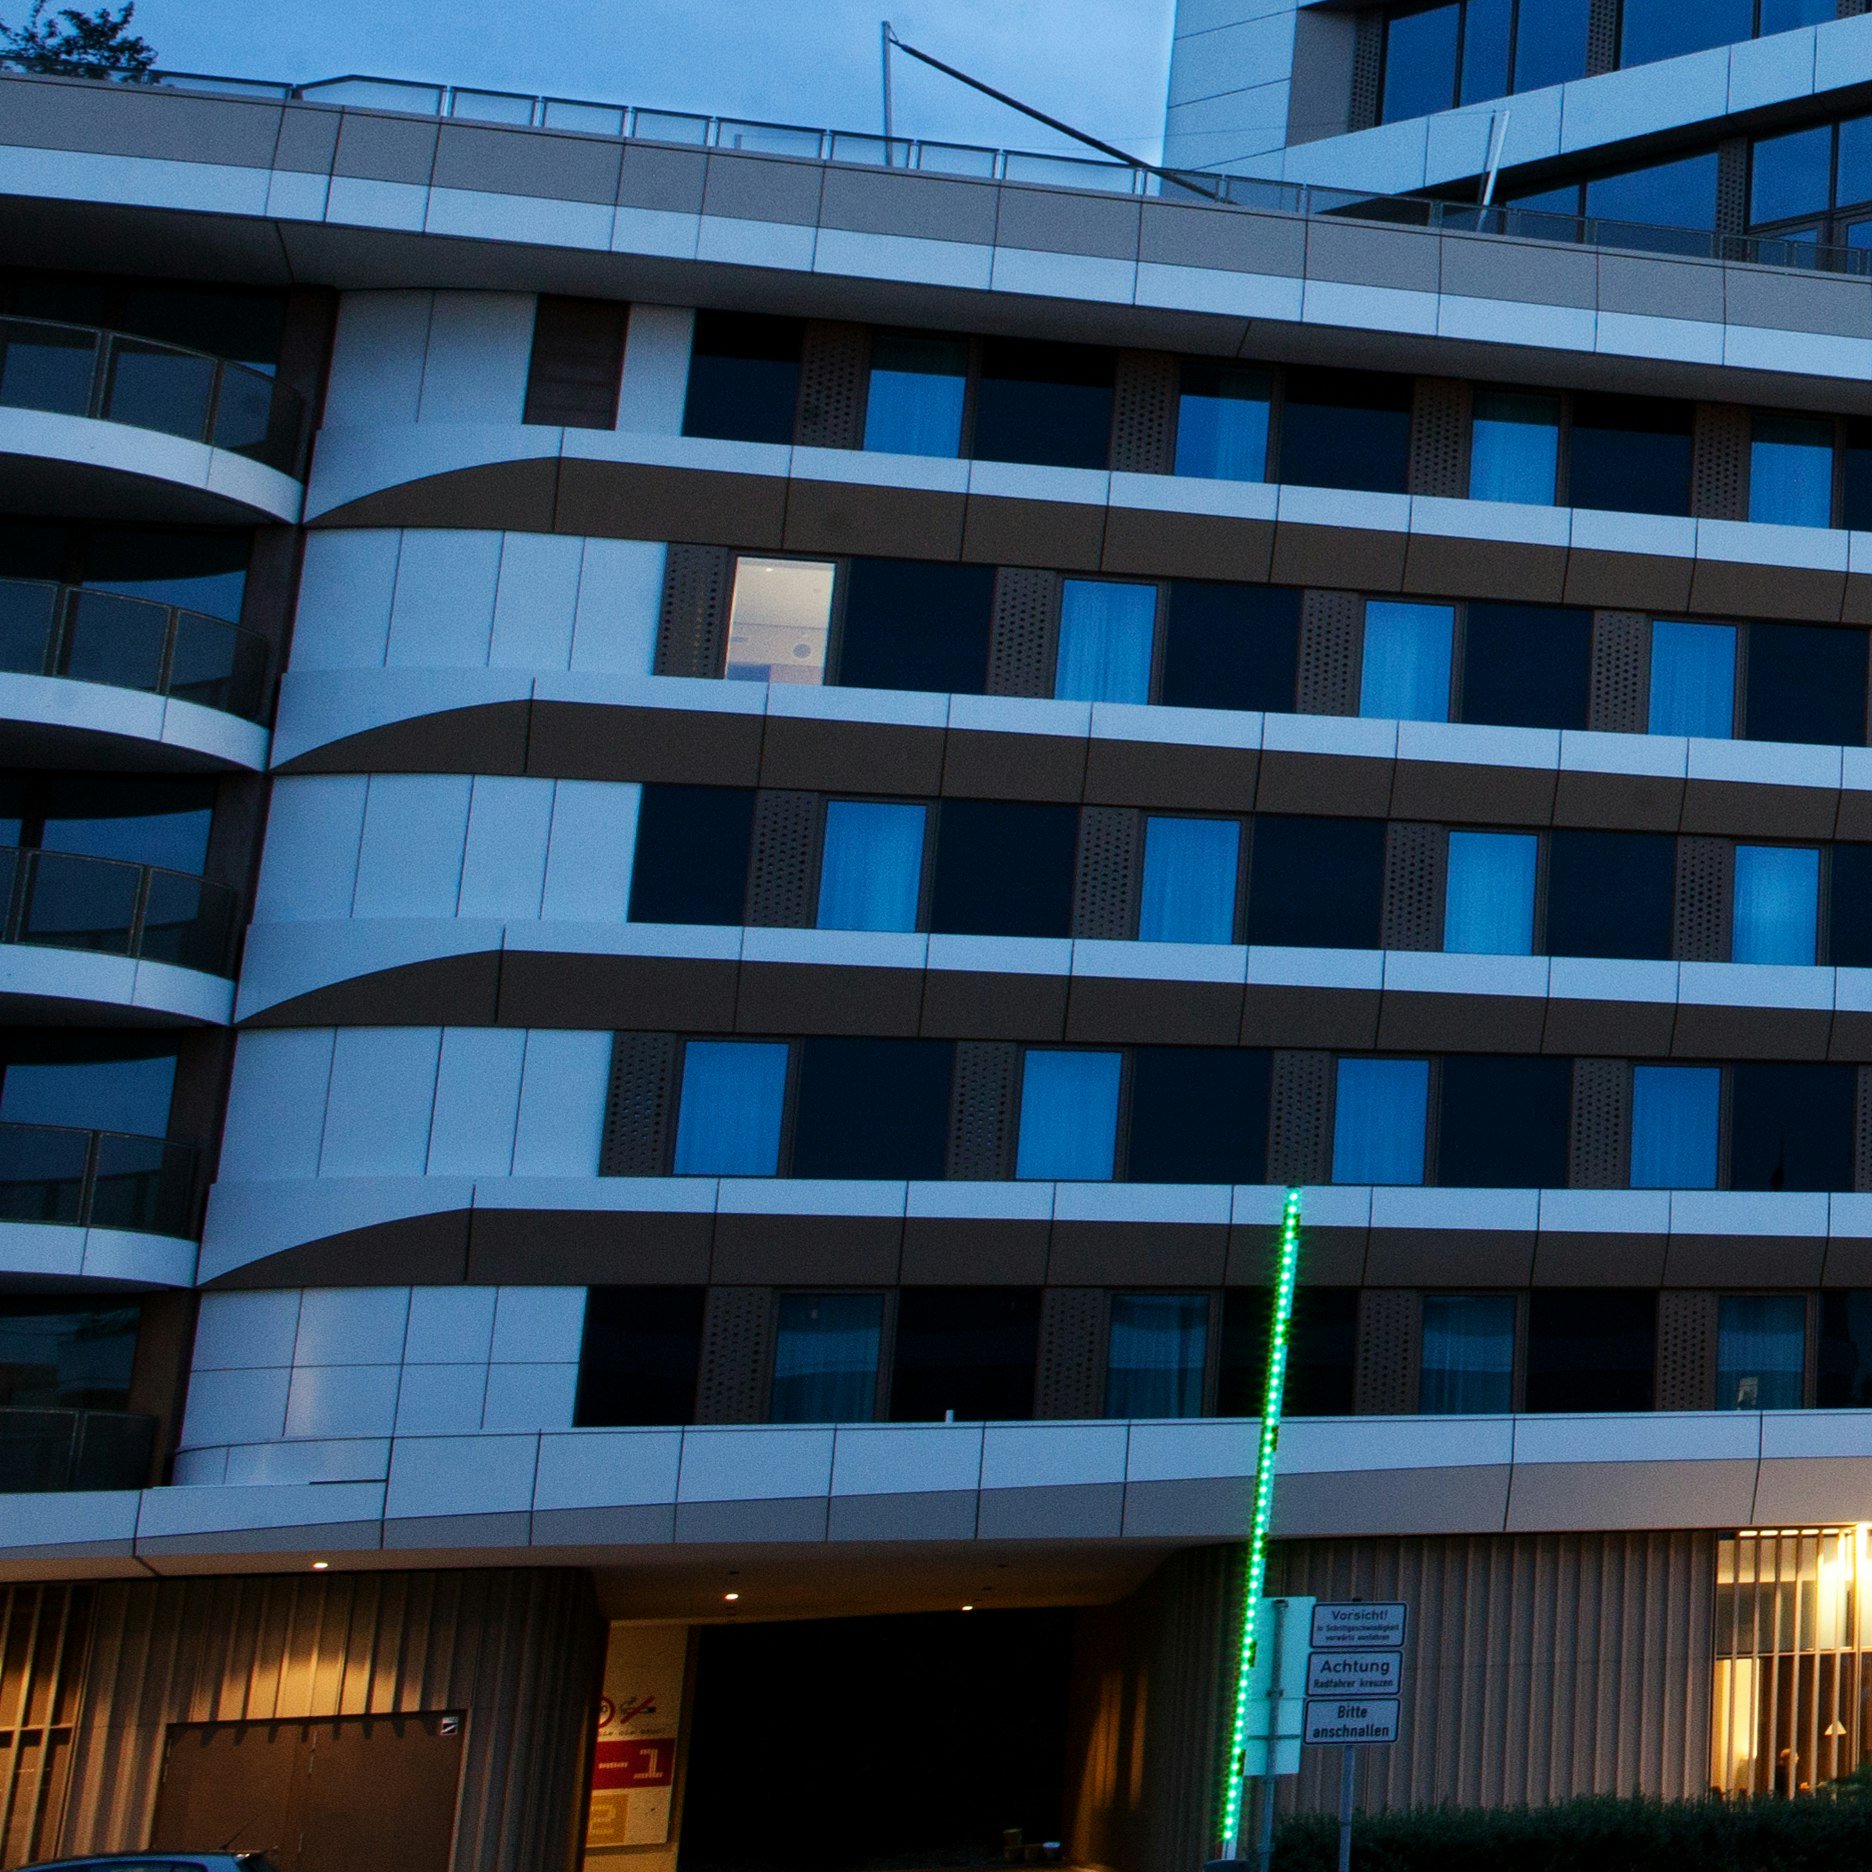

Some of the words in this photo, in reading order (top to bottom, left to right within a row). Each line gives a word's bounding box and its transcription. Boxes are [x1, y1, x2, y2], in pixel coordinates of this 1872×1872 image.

[1331, 1609, 1389, 1621] Vorsicht!
[1320, 1659, 1391, 1676] Achtung
[1313, 1679, 1356, 1688] Radfahrer
[1360, 1678, 1394, 1687] kreuzen
[1337, 1705, 1368, 1719] Bitte
[1312, 1724, 1390, 1738] anschnallen
